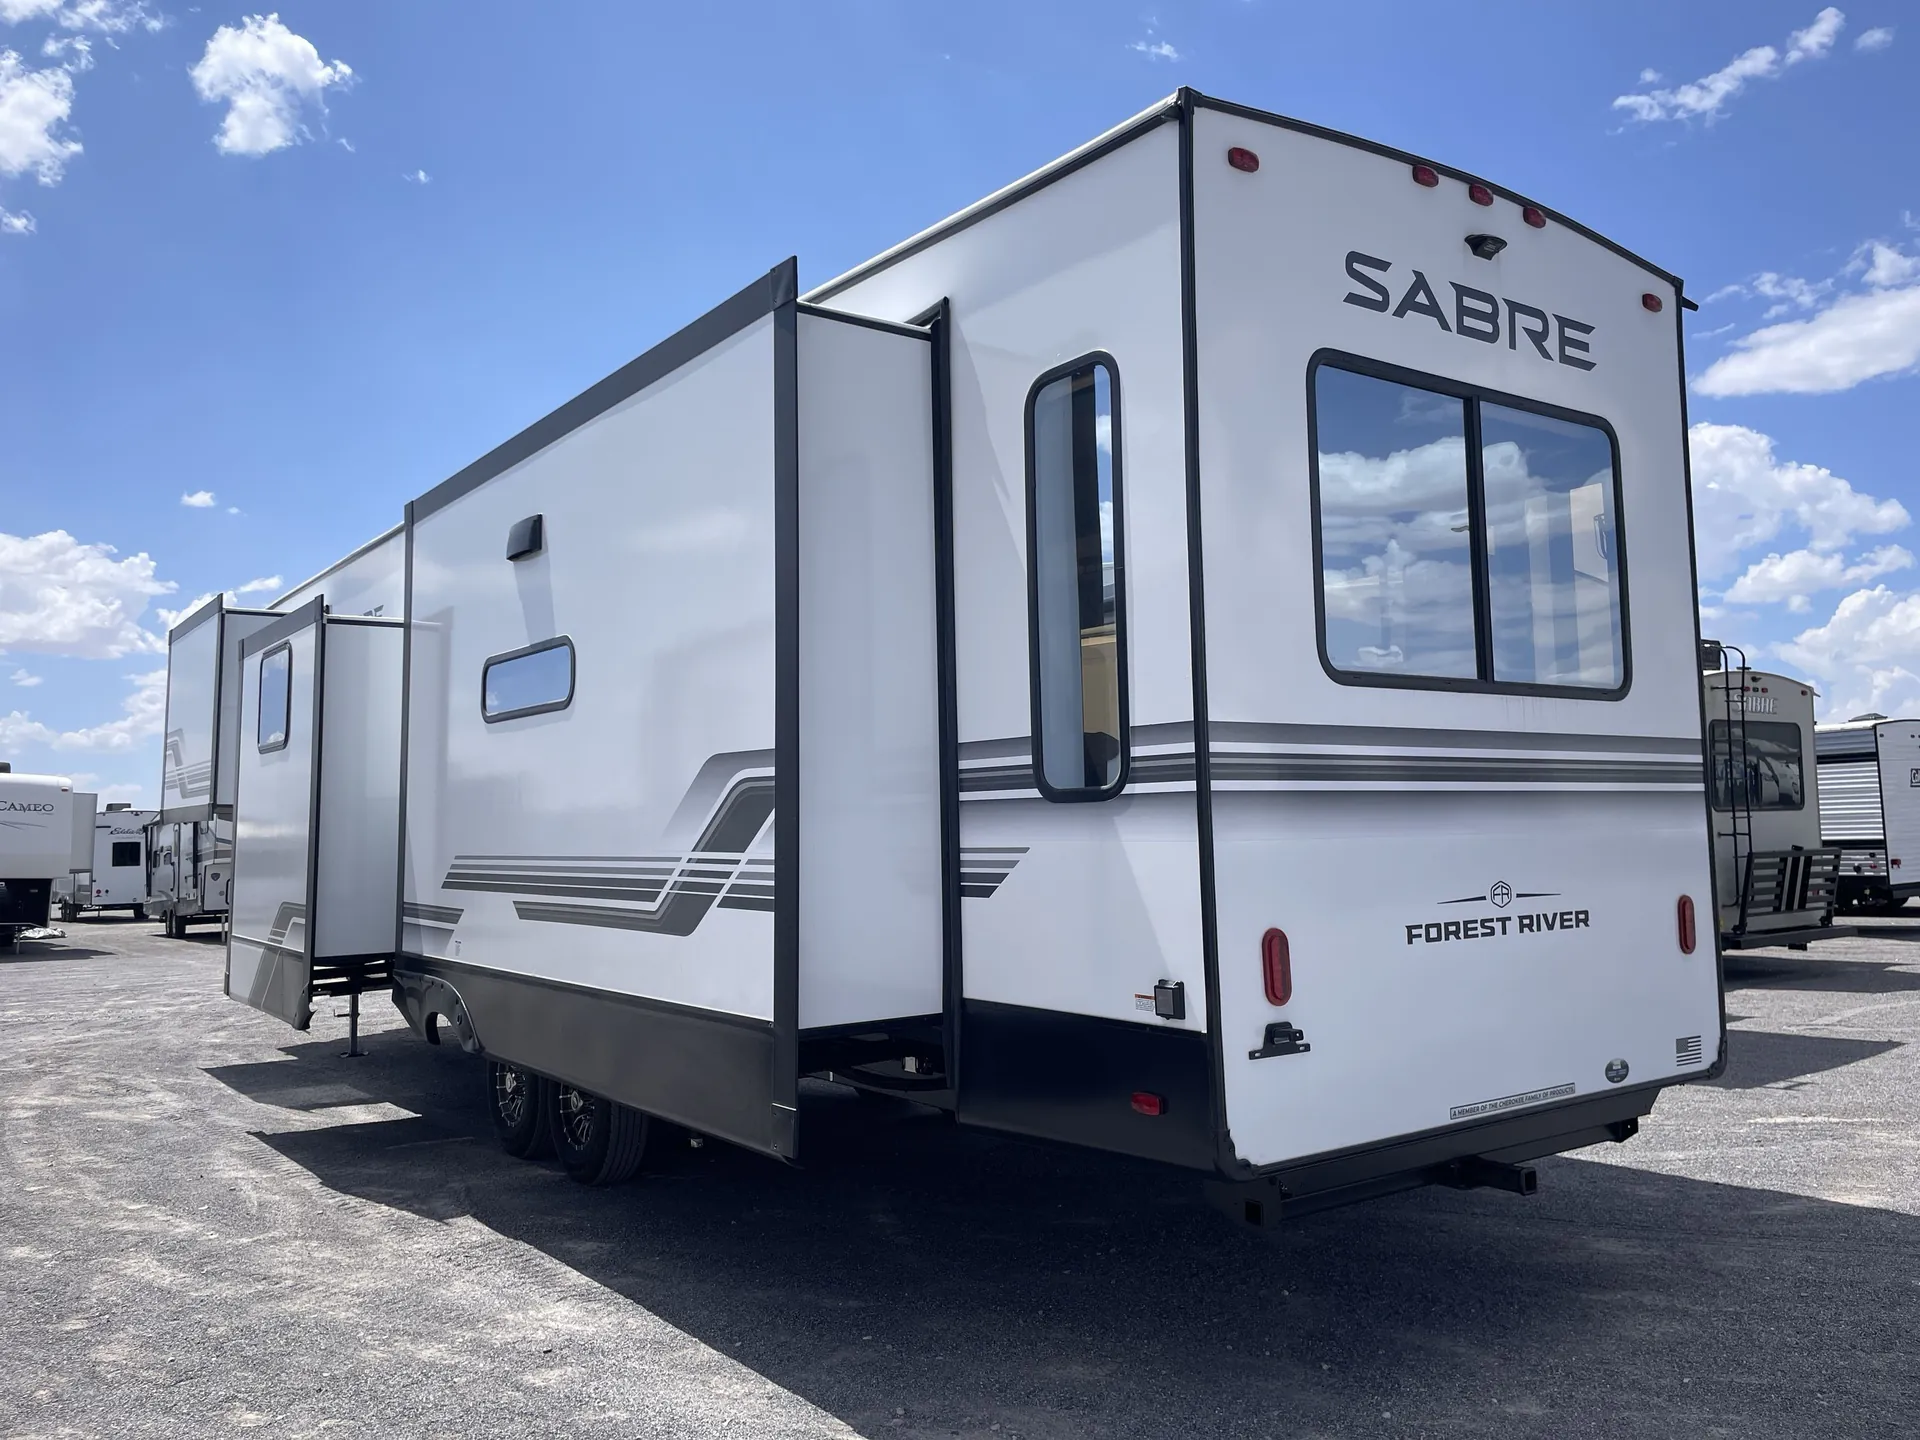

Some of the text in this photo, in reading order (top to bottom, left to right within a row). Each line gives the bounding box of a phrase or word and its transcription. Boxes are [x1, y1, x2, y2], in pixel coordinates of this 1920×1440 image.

[1343, 250, 1597, 372] SABRE
[1405, 909, 1590, 945] FOREST RIVER
[1457, 1105, 1479, 1116] MEMBER
[1480, 1103, 1488, 1112] OF
[1488, 1101, 1498, 1109] THE
[1498, 1097, 1524, 1108] CHEROKEE
[1524, 1094, 1541, 1102] FAMILY
[1549, 1085, 1574, 1097] PRODUCTS
